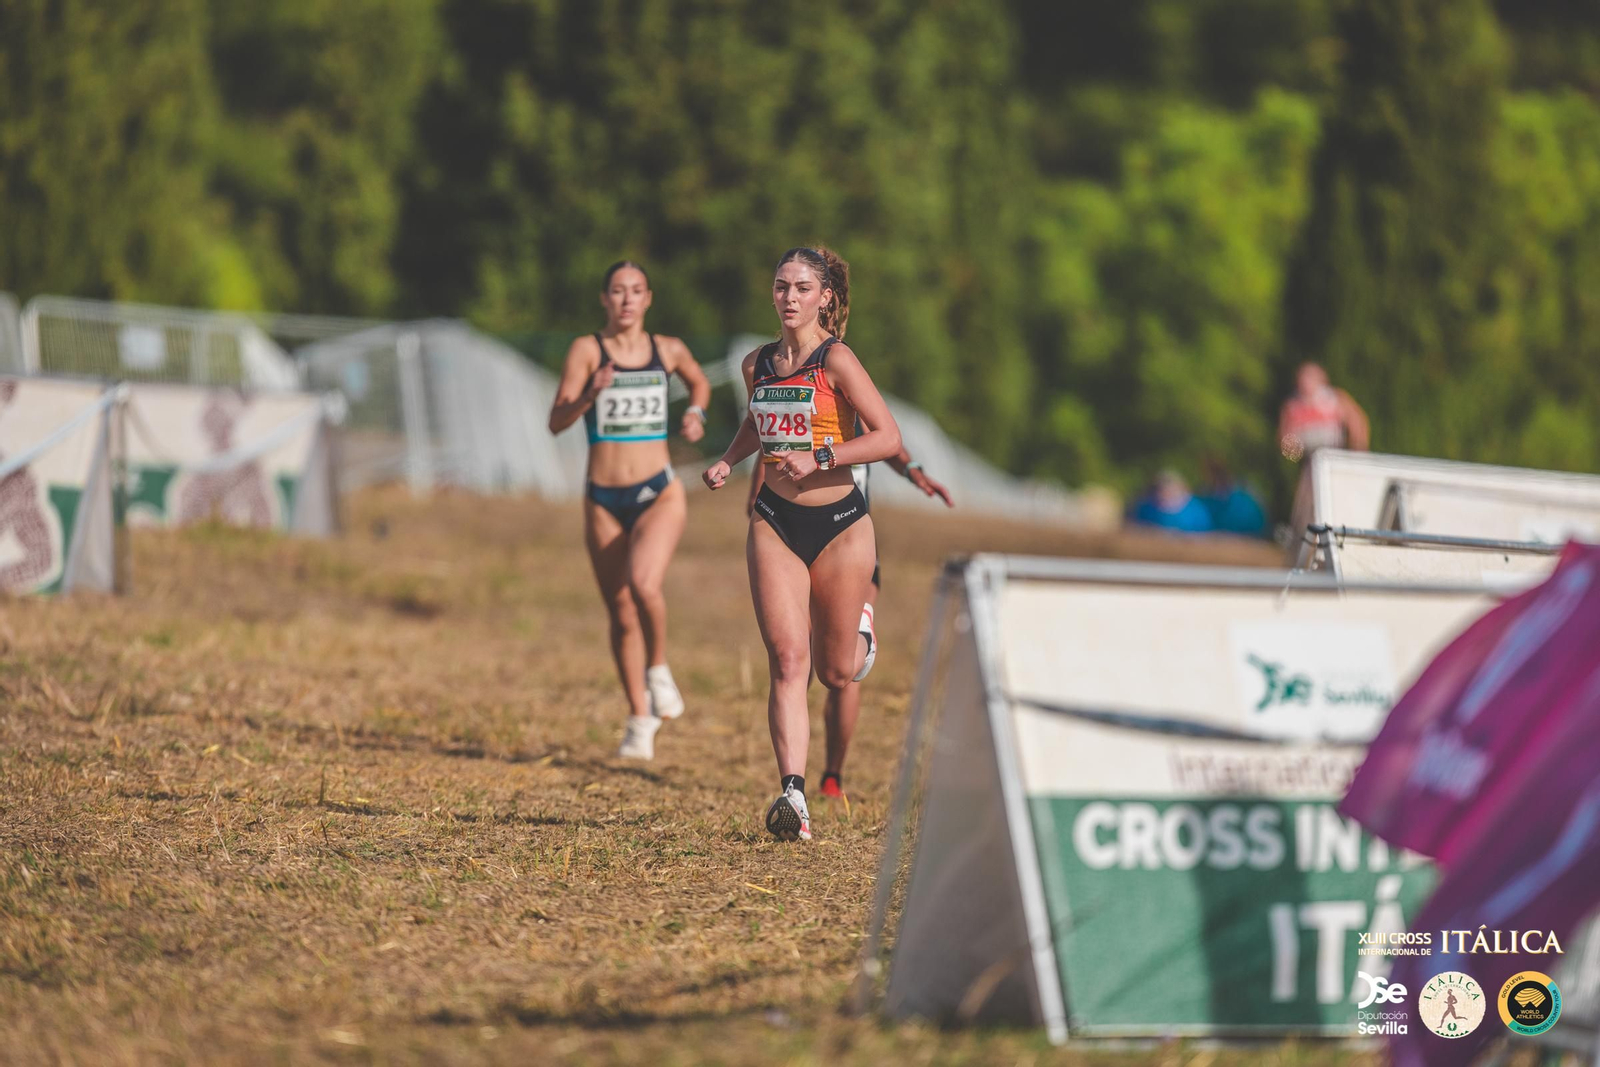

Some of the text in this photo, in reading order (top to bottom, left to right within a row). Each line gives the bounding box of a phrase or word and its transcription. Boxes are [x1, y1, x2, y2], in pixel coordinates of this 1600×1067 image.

[767, 388, 796, 398] ITÁLICA
[605, 396, 662, 418] 2232
[757, 412, 808, 437] 2248
[1072, 800, 1286, 872] CROSS
[1268, 873, 1407, 1005] ITÁ
